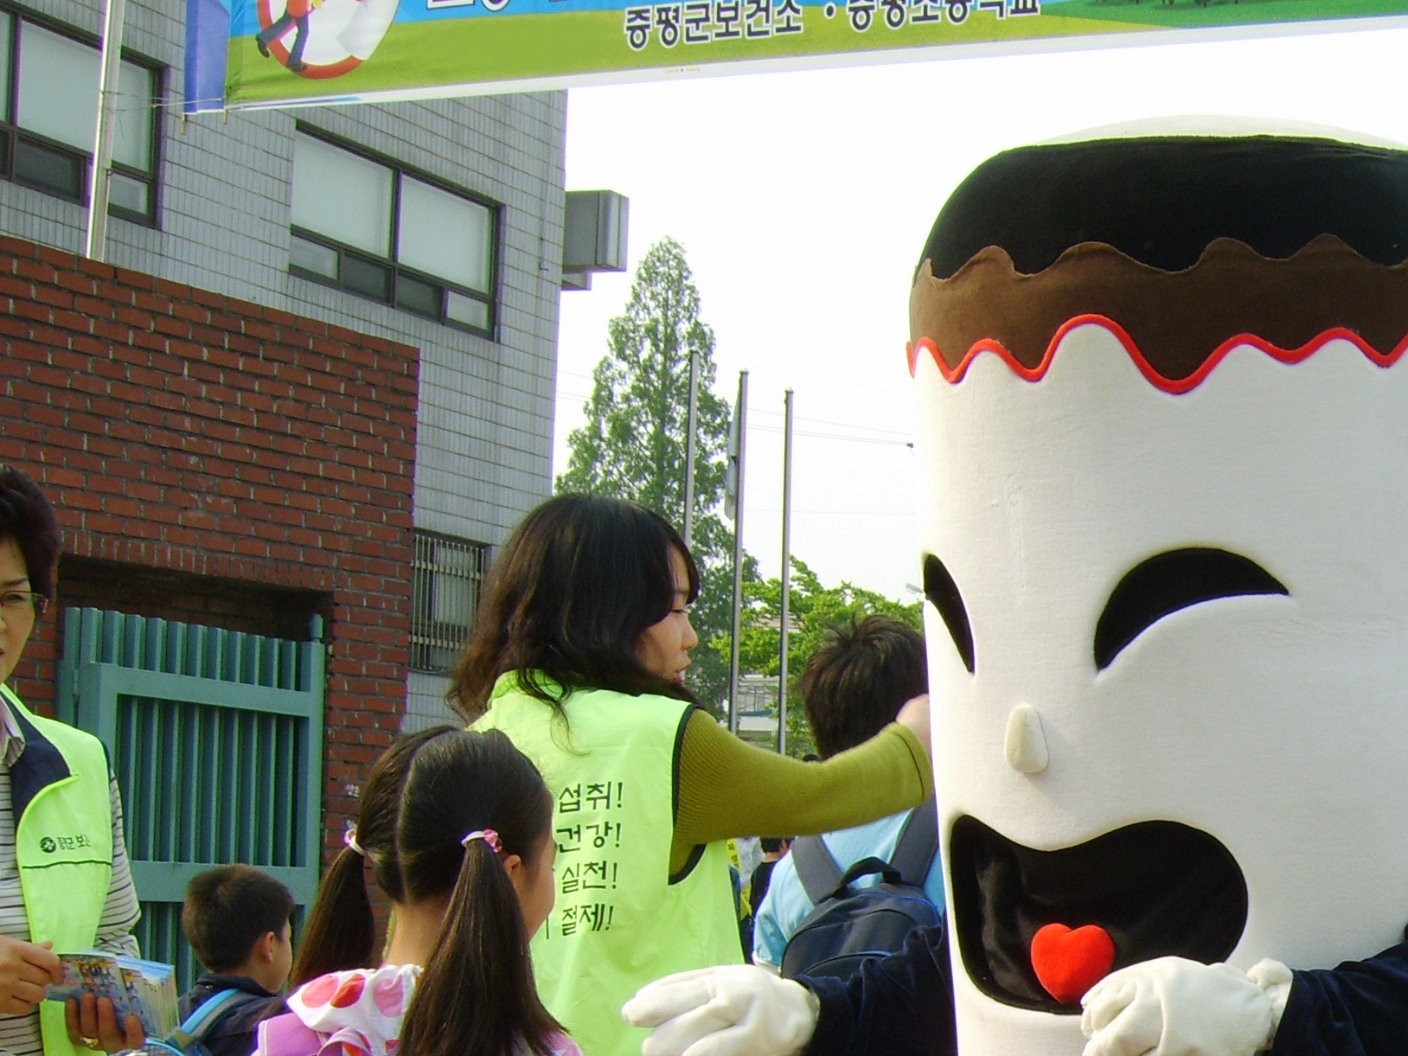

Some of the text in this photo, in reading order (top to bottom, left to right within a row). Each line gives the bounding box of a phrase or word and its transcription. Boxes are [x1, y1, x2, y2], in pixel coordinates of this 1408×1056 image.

[625, 0, 803, 49] 증평군보건소
[558, 781, 623, 813] 섭취!
[556, 821, 621, 853] 건강!
[561, 860, 618, 894] 실천!
[561, 903, 614, 936] 절제!
